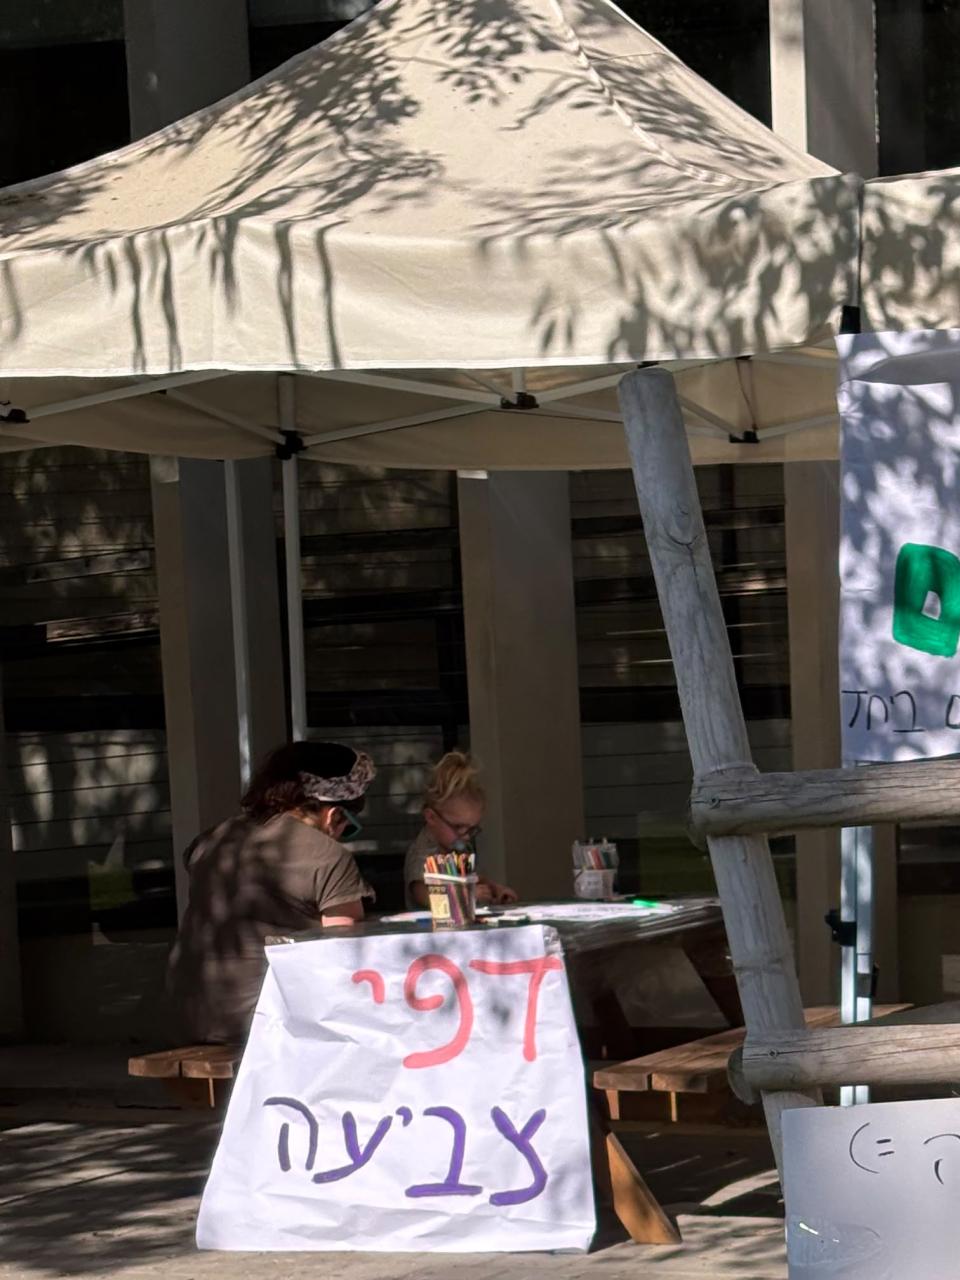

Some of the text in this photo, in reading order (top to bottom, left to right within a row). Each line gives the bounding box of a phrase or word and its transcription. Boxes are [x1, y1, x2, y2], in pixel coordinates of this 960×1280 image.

[841, 690, 925, 733] ביחד
[351, 953, 564, 1070] דפי
[262, 1096, 548, 1207] צביעה
